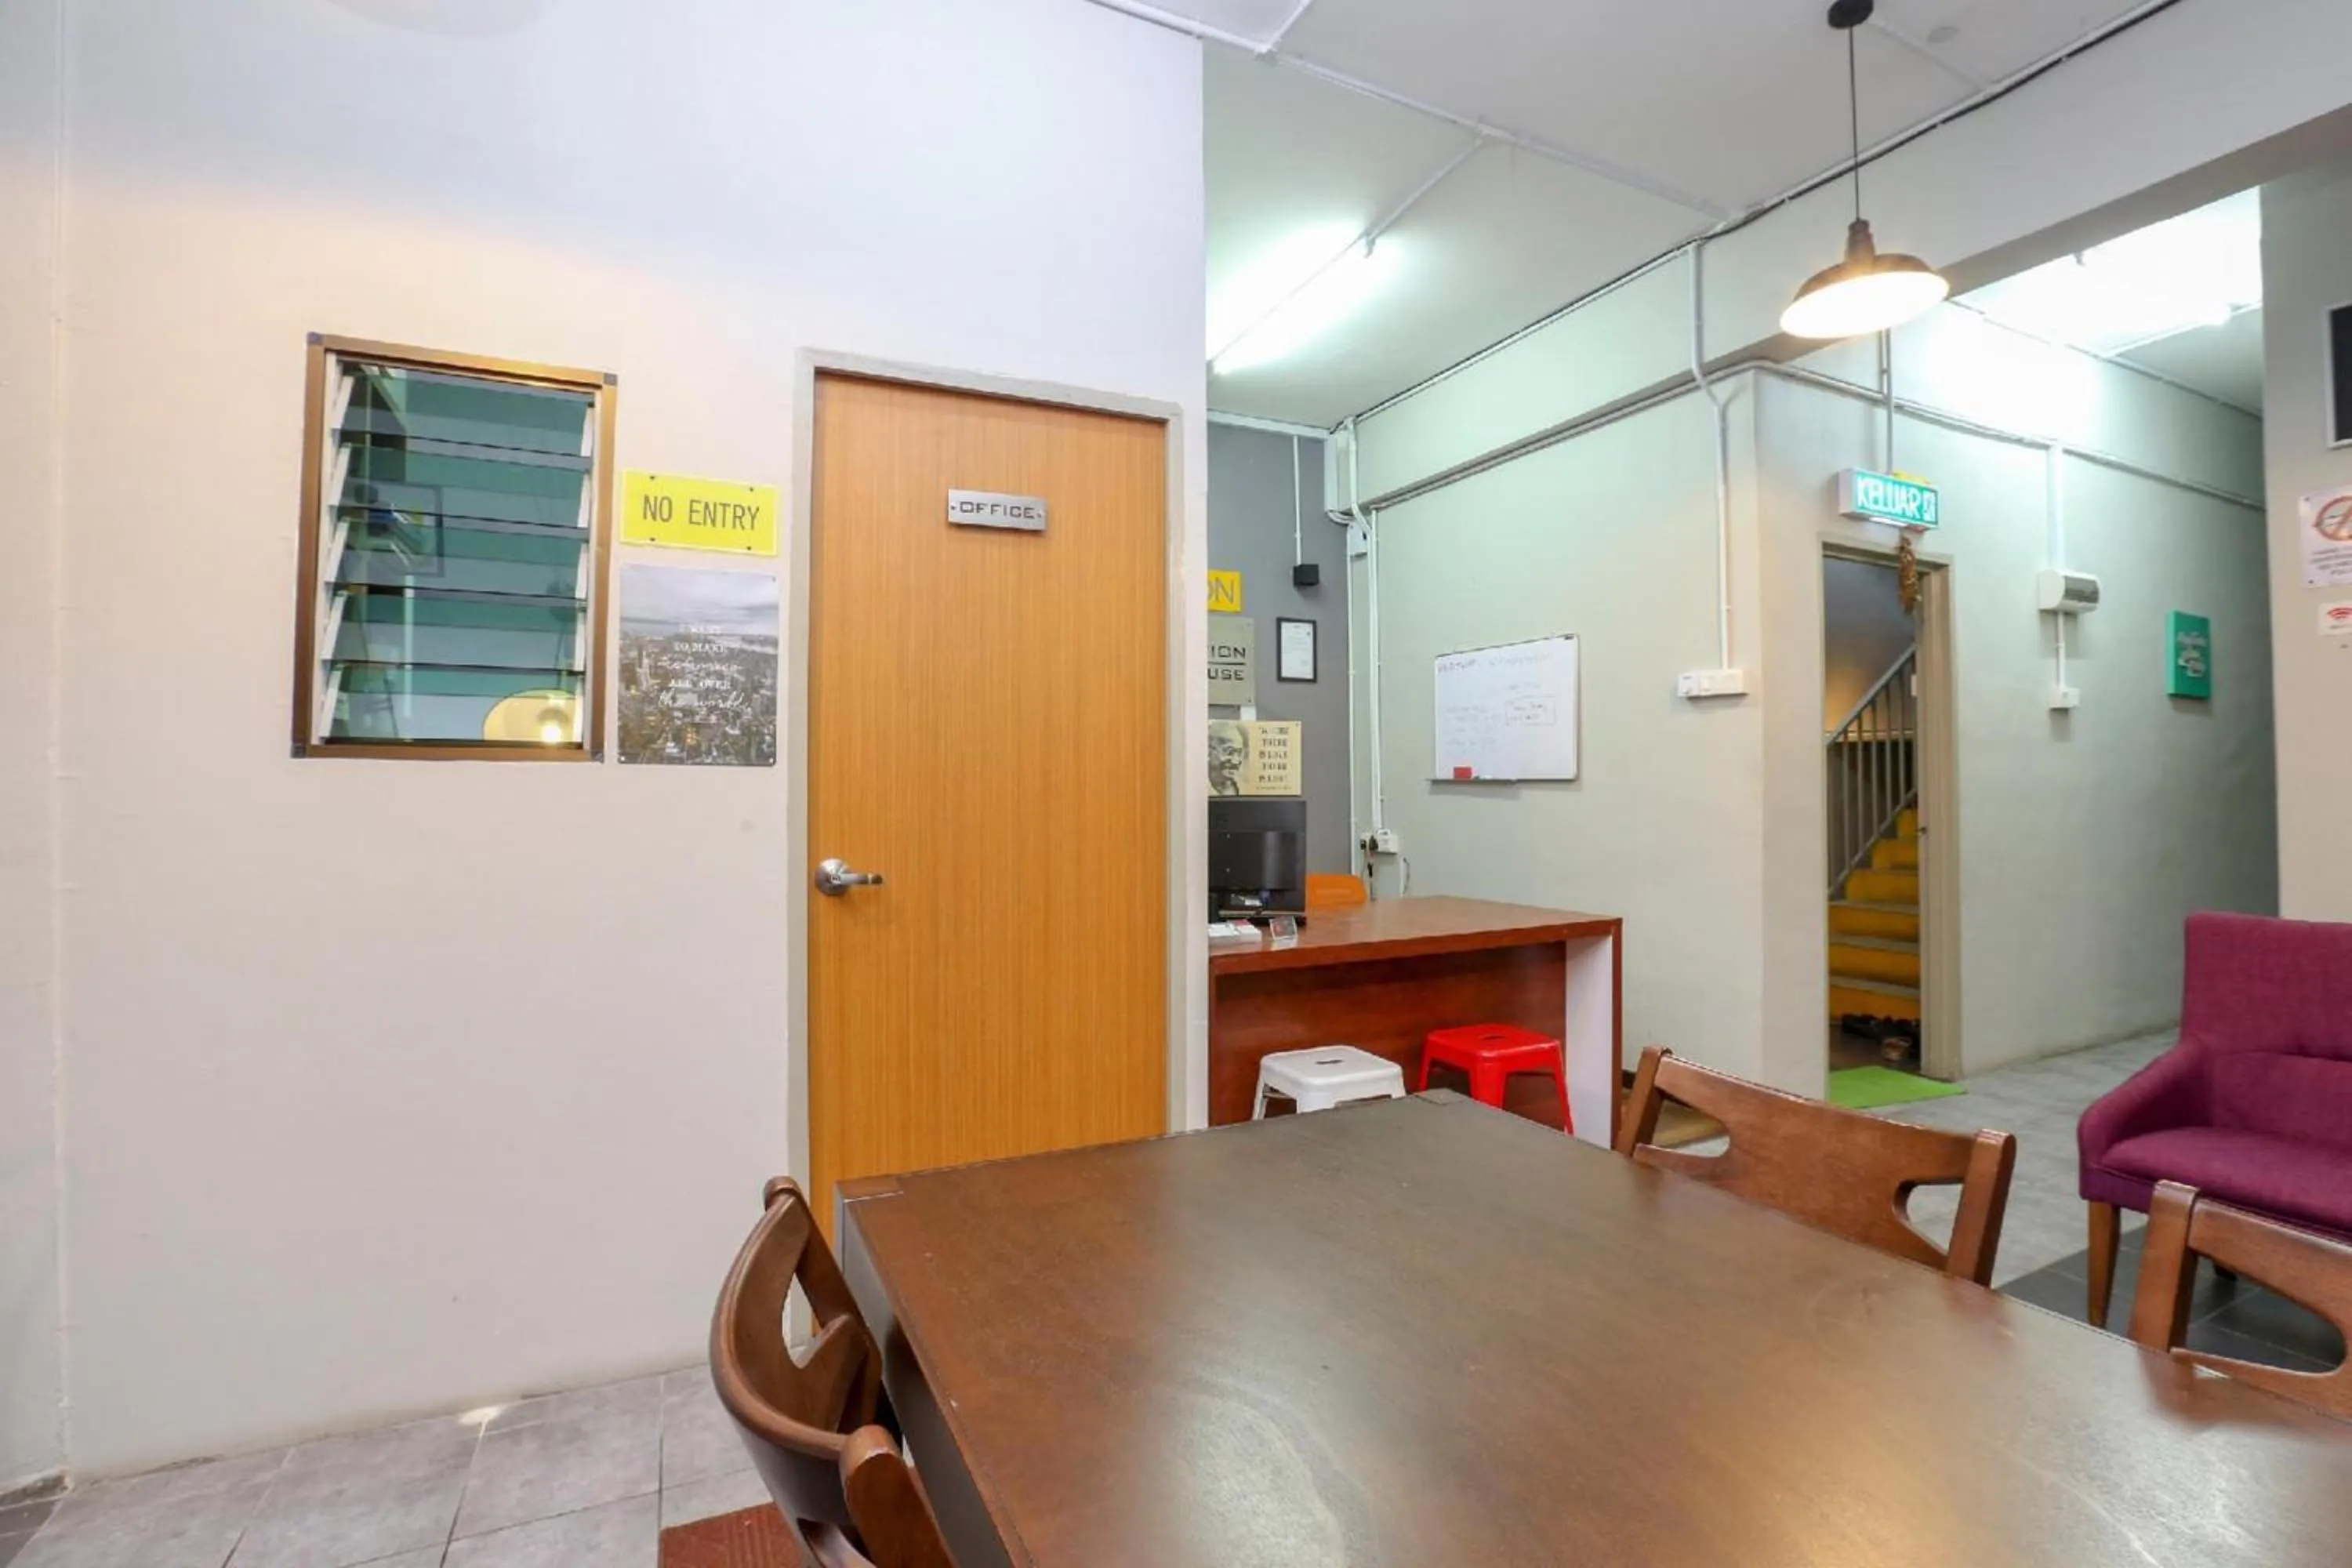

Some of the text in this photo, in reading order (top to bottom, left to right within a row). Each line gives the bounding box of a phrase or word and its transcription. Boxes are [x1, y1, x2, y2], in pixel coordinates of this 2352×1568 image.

[642, 493, 760, 531] NO ENTRY
[960, 501, 1036, 519] OFFICE
